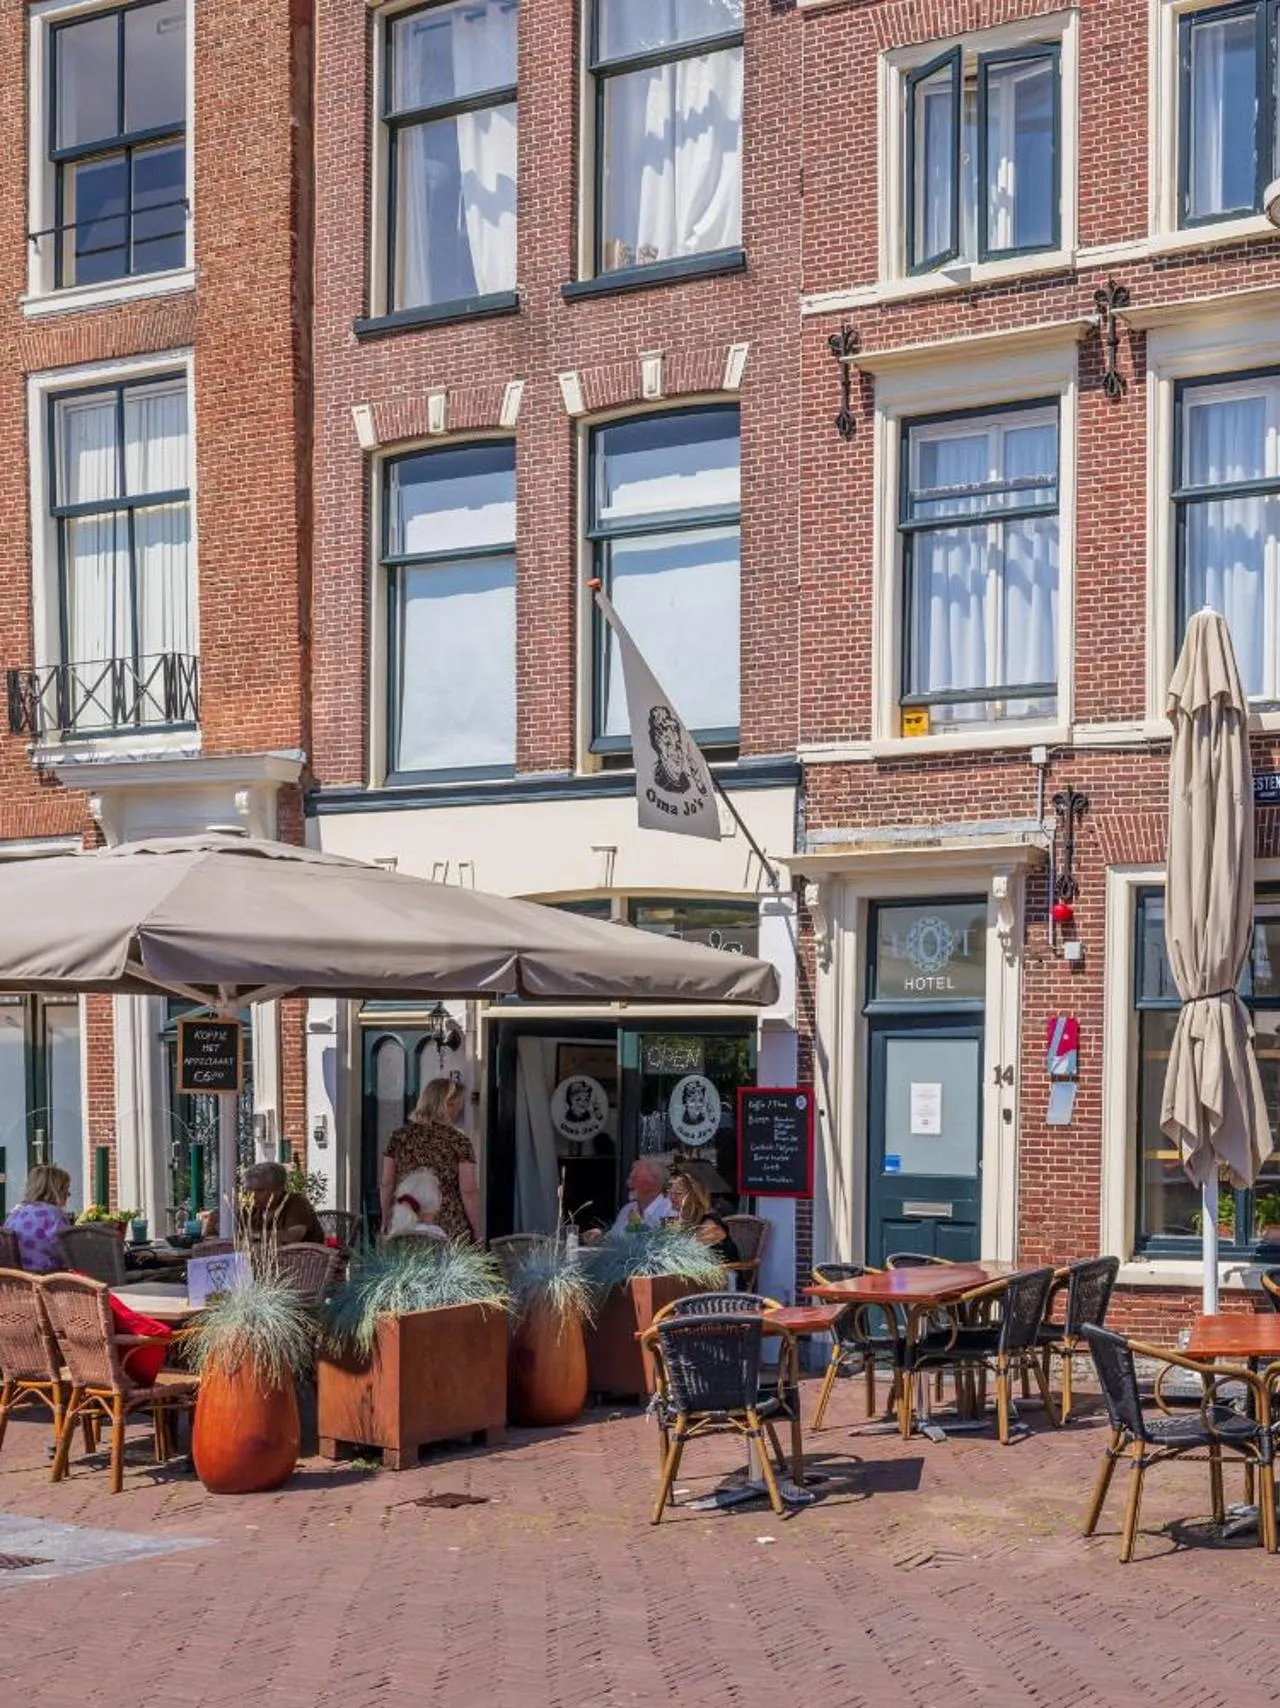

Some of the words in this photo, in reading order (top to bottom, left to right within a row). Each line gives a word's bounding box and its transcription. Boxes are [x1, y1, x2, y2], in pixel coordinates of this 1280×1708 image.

[646, 788, 679, 816] Oma
[683, 797, 705, 816] Jo's
[903, 976, 956, 991] HOTEL
[993, 1065, 1014, 1087] 14
